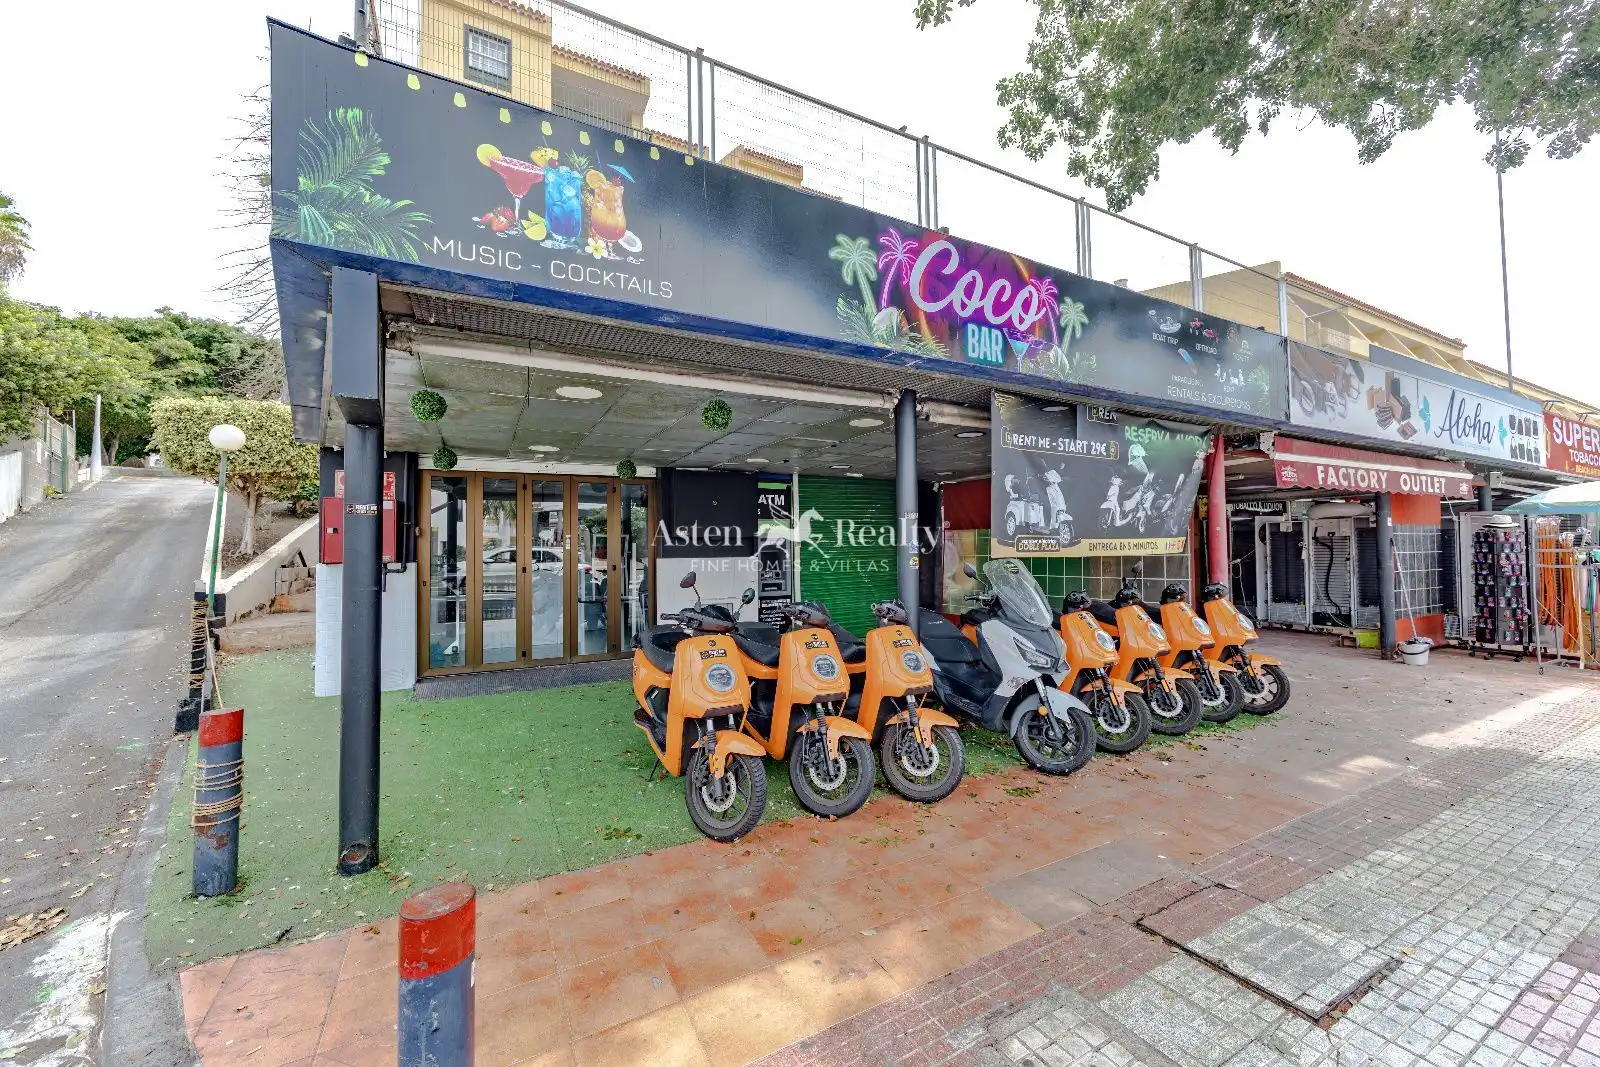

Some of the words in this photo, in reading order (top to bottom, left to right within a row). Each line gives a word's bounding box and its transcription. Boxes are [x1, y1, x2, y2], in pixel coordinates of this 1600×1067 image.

[433, 235, 522, 271] MUSIC
[550, 260, 673, 299] COCKTAILS
[909, 239, 1047, 331] Coco
[967, 323, 1003, 363] BAR
[1152, 332, 1167, 343] BOAT
[1167, 335, 1179, 346] TRIP
[1167, 385, 1200, 401] RENTALS
[1208, 393, 1251, 411] EXCURSIONS
[1433, 389, 1496, 445] Aloha
[1012, 433, 1037, 446] RENT
[1038, 436, 1051, 449] ME
[1058, 438, 1089, 454] START
[1090, 442, 1107, 456] 29€
[1552, 416, 1600, 454] SUPER
[1316, 465, 1388, 489] FACTORY
[1399, 473, 1447, 494] OUTLET
[757, 494, 785, 506] ATM
[1088, 542, 1118, 552] ENTREGA
[1132, 540, 1159, 551] MINUTOS
